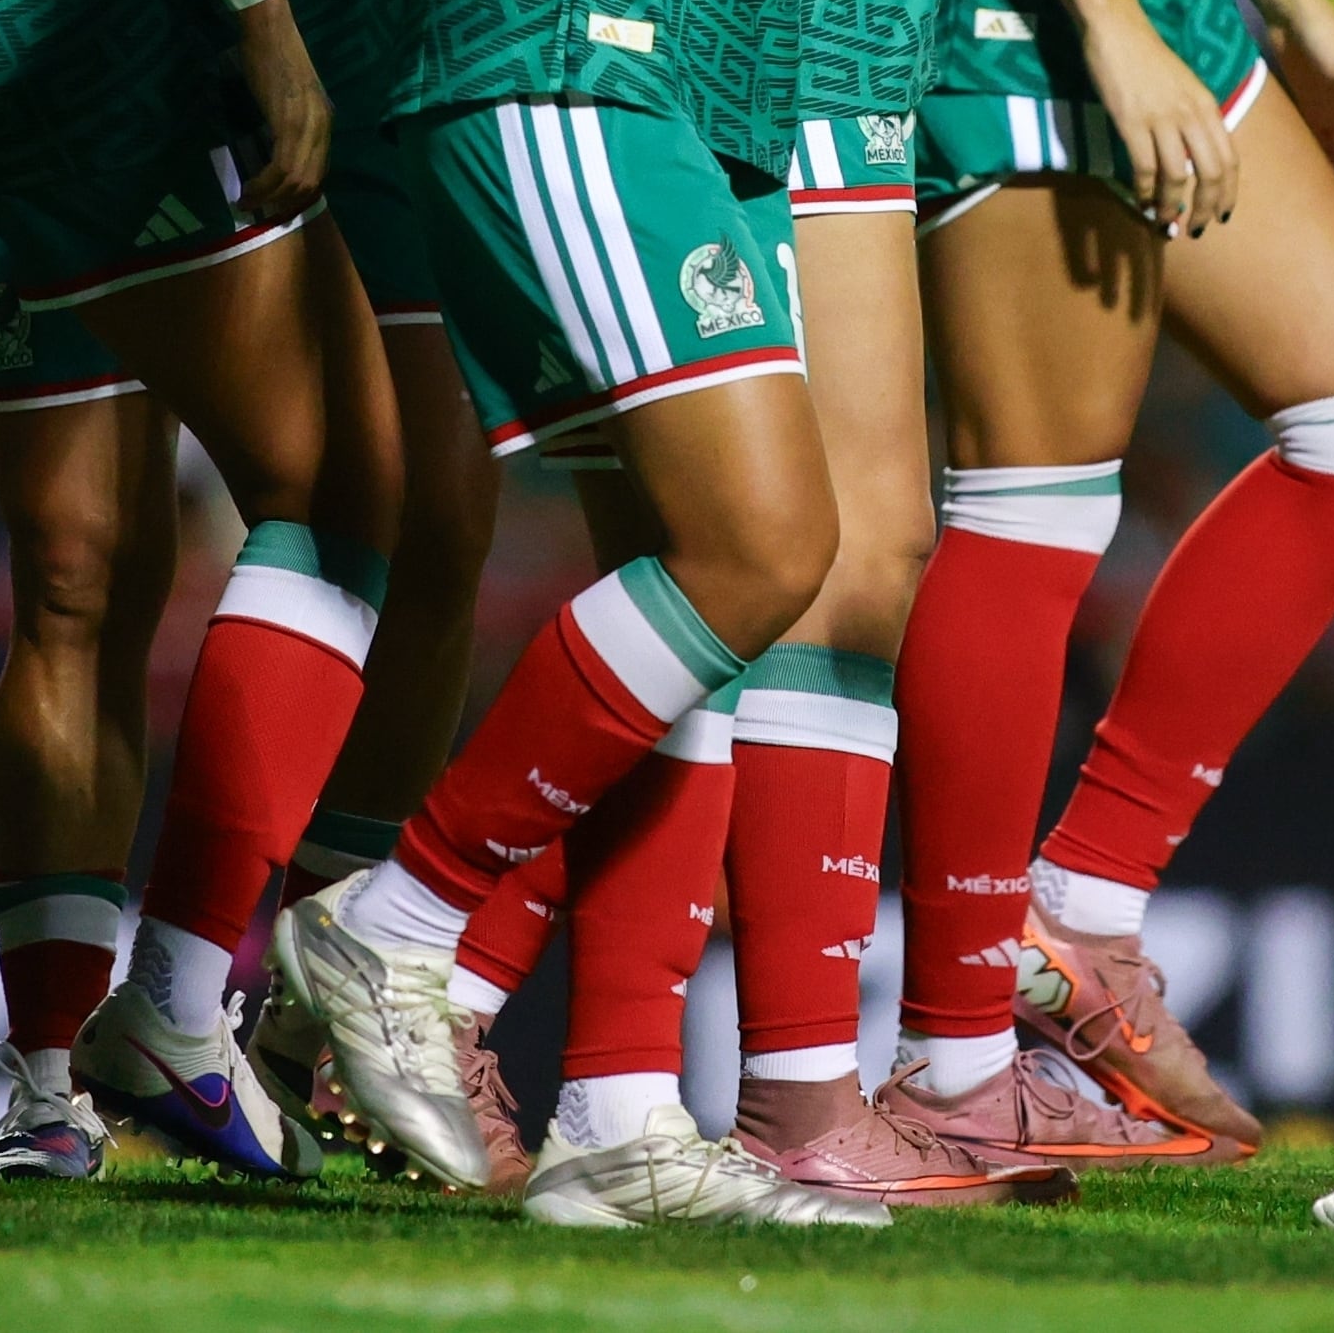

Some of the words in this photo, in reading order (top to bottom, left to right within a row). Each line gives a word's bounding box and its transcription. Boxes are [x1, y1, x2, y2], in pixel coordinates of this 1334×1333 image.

[700, 311, 761, 335] MÉXICO
[822, 854, 880, 884] MÉXI
[946, 873, 1030, 895] MÉXIC
